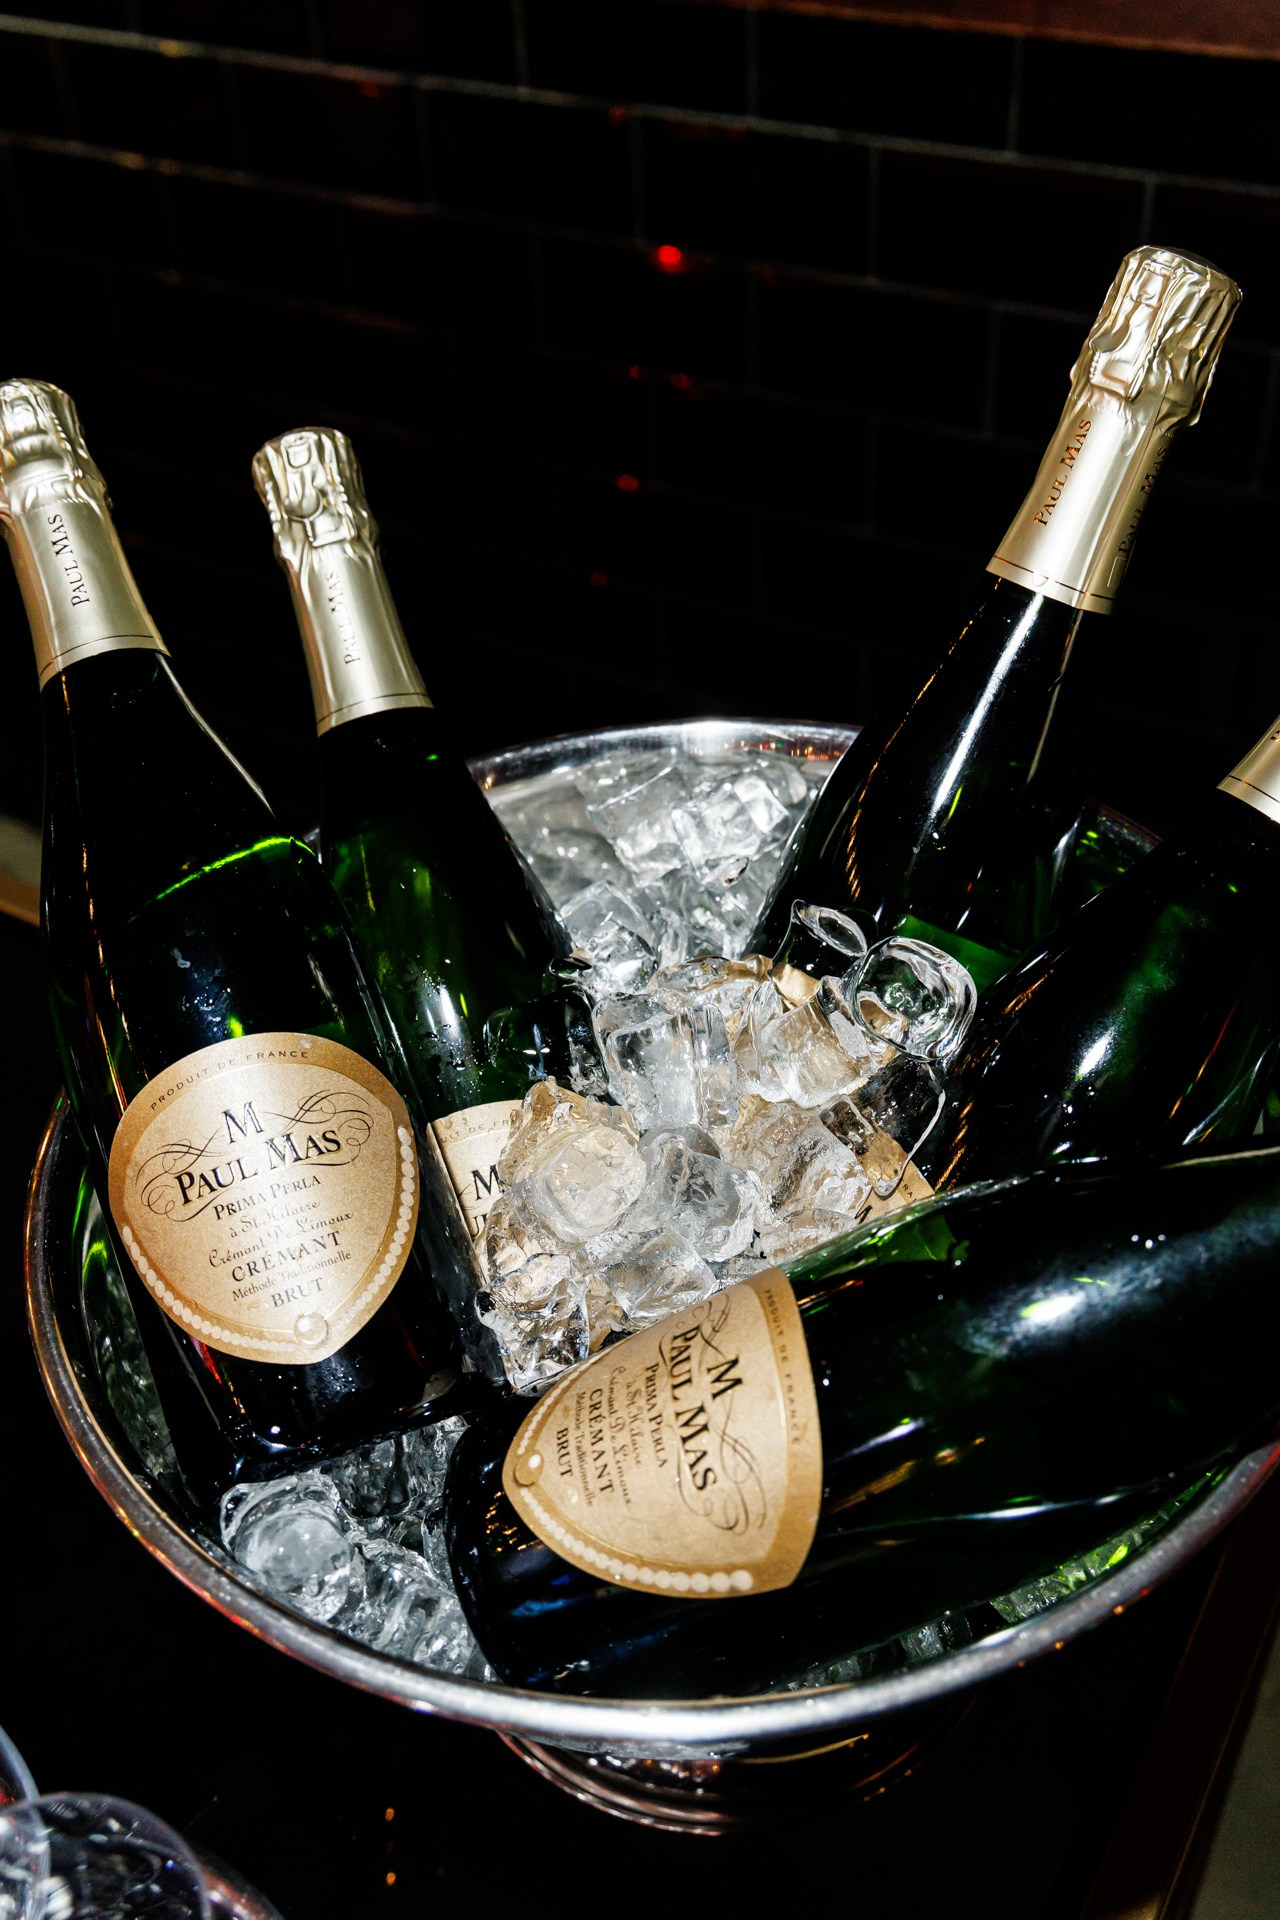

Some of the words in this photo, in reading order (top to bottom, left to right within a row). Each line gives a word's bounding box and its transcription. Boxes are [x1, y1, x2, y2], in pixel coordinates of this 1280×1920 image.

[1033, 475, 1068, 526] PAUL
[1059, 419, 1092, 469] MAS
[47, 513, 73, 557] MAS
[61, 560, 90, 607] PAUL
[151, 1068, 209, 1110] PRODUIT
[218, 1059, 237, 1070] DE
[246, 1050, 309, 1061] FRANCE
[222, 1101, 264, 1144] M
[174, 1156, 258, 1206] PAUL
[265, 1130, 341, 1170] MAS
[213, 1192, 267, 1221] PRIMA
[269, 1175, 322, 1199] PERLA
[209, 1237, 265, 1268] Crémant
[232, 1231, 341, 1282] CRÉMANT
[232, 1276, 277, 1301] Méthode
[279, 1250, 352, 1281] Traditionnelle
[271, 1277, 323, 1308] BRUT
[645, 1362, 660, 1412] PRIMA
[670, 1324, 700, 1401] PAUL
[706, 1355, 744, 1400] M
[556, 1427, 573, 1477] BRUT
[589, 1388, 615, 1494] CRÉMANT
[648, 1413, 668, 1468] PERLA
[675, 1402, 717, 1490] MAS
